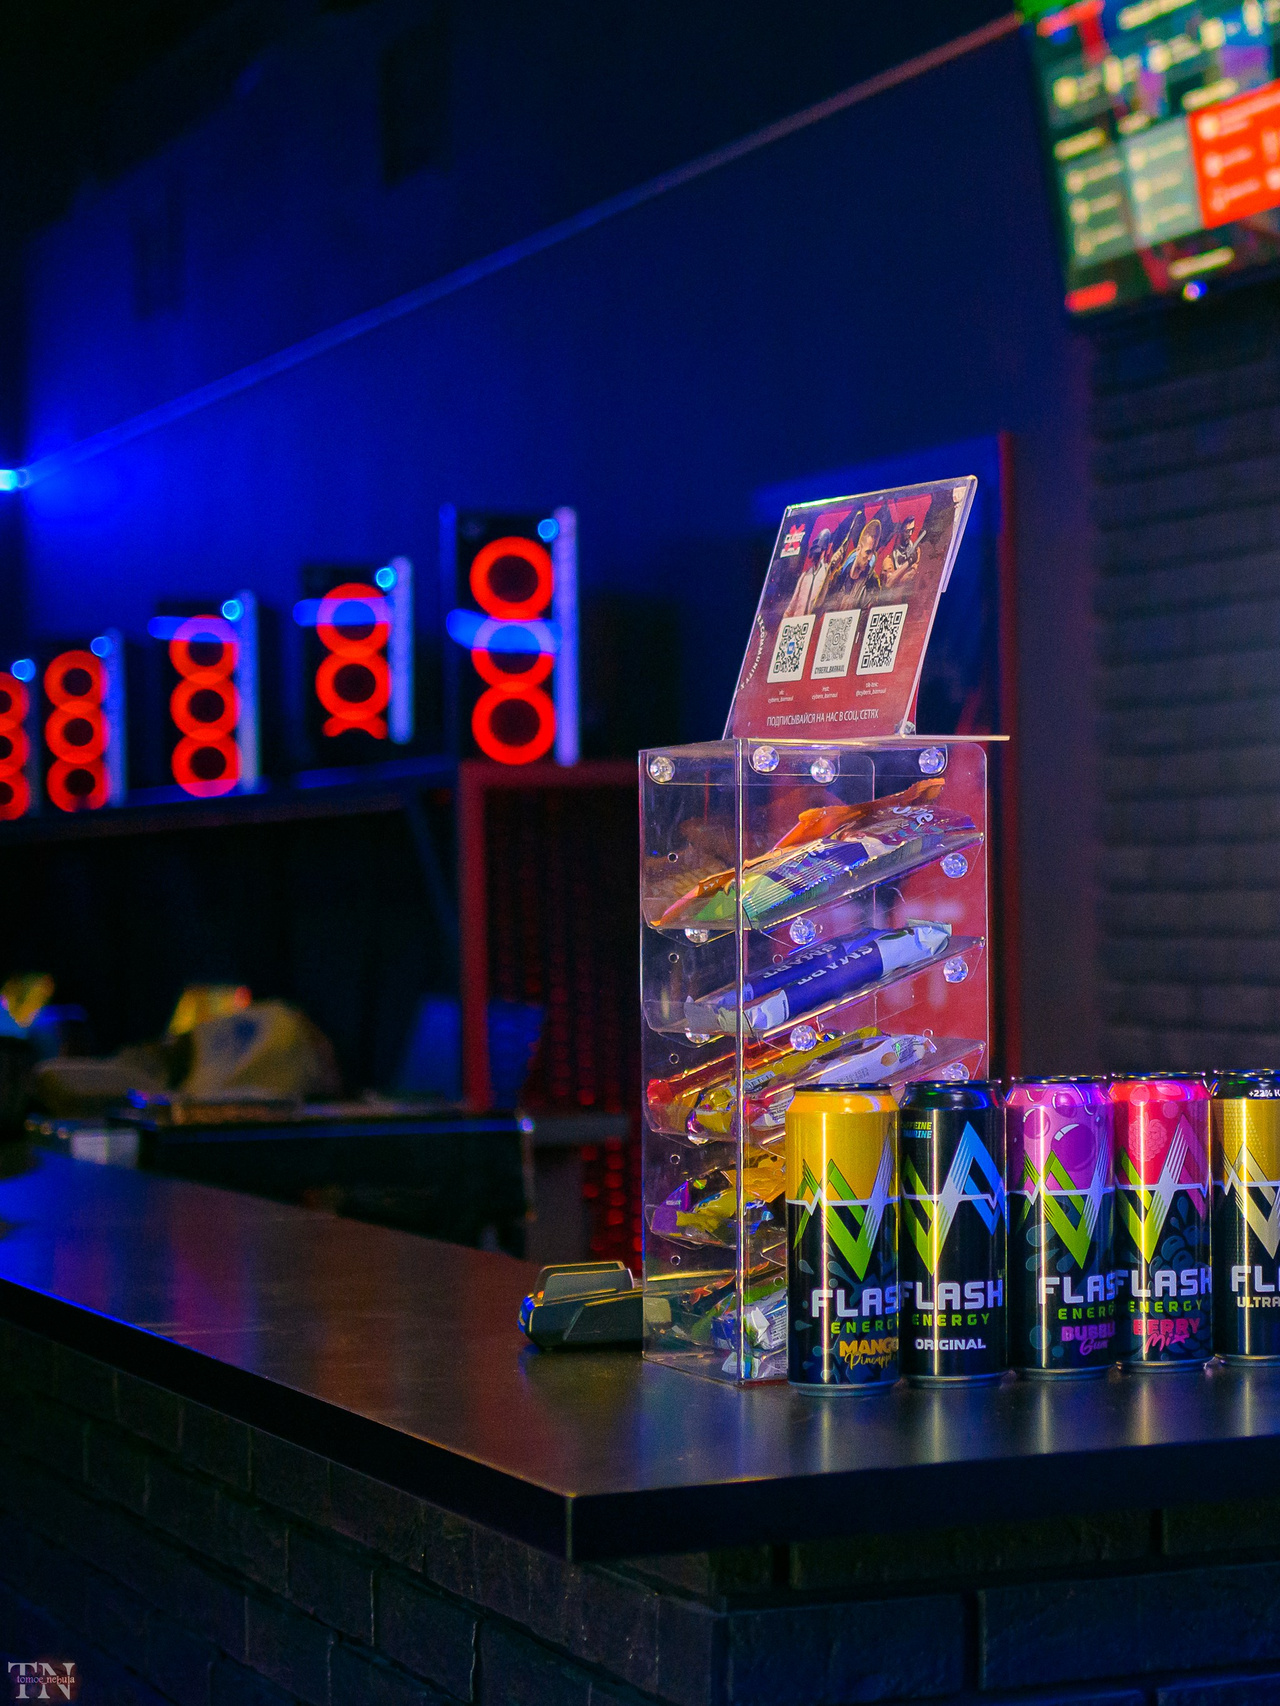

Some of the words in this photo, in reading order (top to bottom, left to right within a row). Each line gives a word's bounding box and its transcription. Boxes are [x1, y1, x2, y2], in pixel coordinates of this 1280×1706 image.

[766, 712, 816, 727] ПОДПИСЫВАЙСЯ
[817, 713, 825, 723] НА
[826, 711, 839, 722] НАС
[839, 711, 844, 721] В
[860, 708, 879, 720] СЕТЯХ
[1038, 1272, 1115, 1305] FLAS
[1116, 1267, 1212, 1298] FLASH
[811, 1286, 899, 1318] FLAS
[901, 1280, 1003, 1312] FLASH
[1058, 1306, 1115, 1320] ENERG
[1128, 1299, 1202, 1313] ENERGY
[830, 1319, 898, 1334] ENERG
[912, 1313, 990, 1327] ENERGY
[1133, 1318, 1201, 1336] BERRY
[1061, 1321, 1115, 1342] BUBBL
[839, 1336, 899, 1357] MANGO
[915, 1338, 987, 1351] ORIGINAL
[1079, 1337, 1108, 1356] Gum
[1145, 1332, 1190, 1354] Mix
